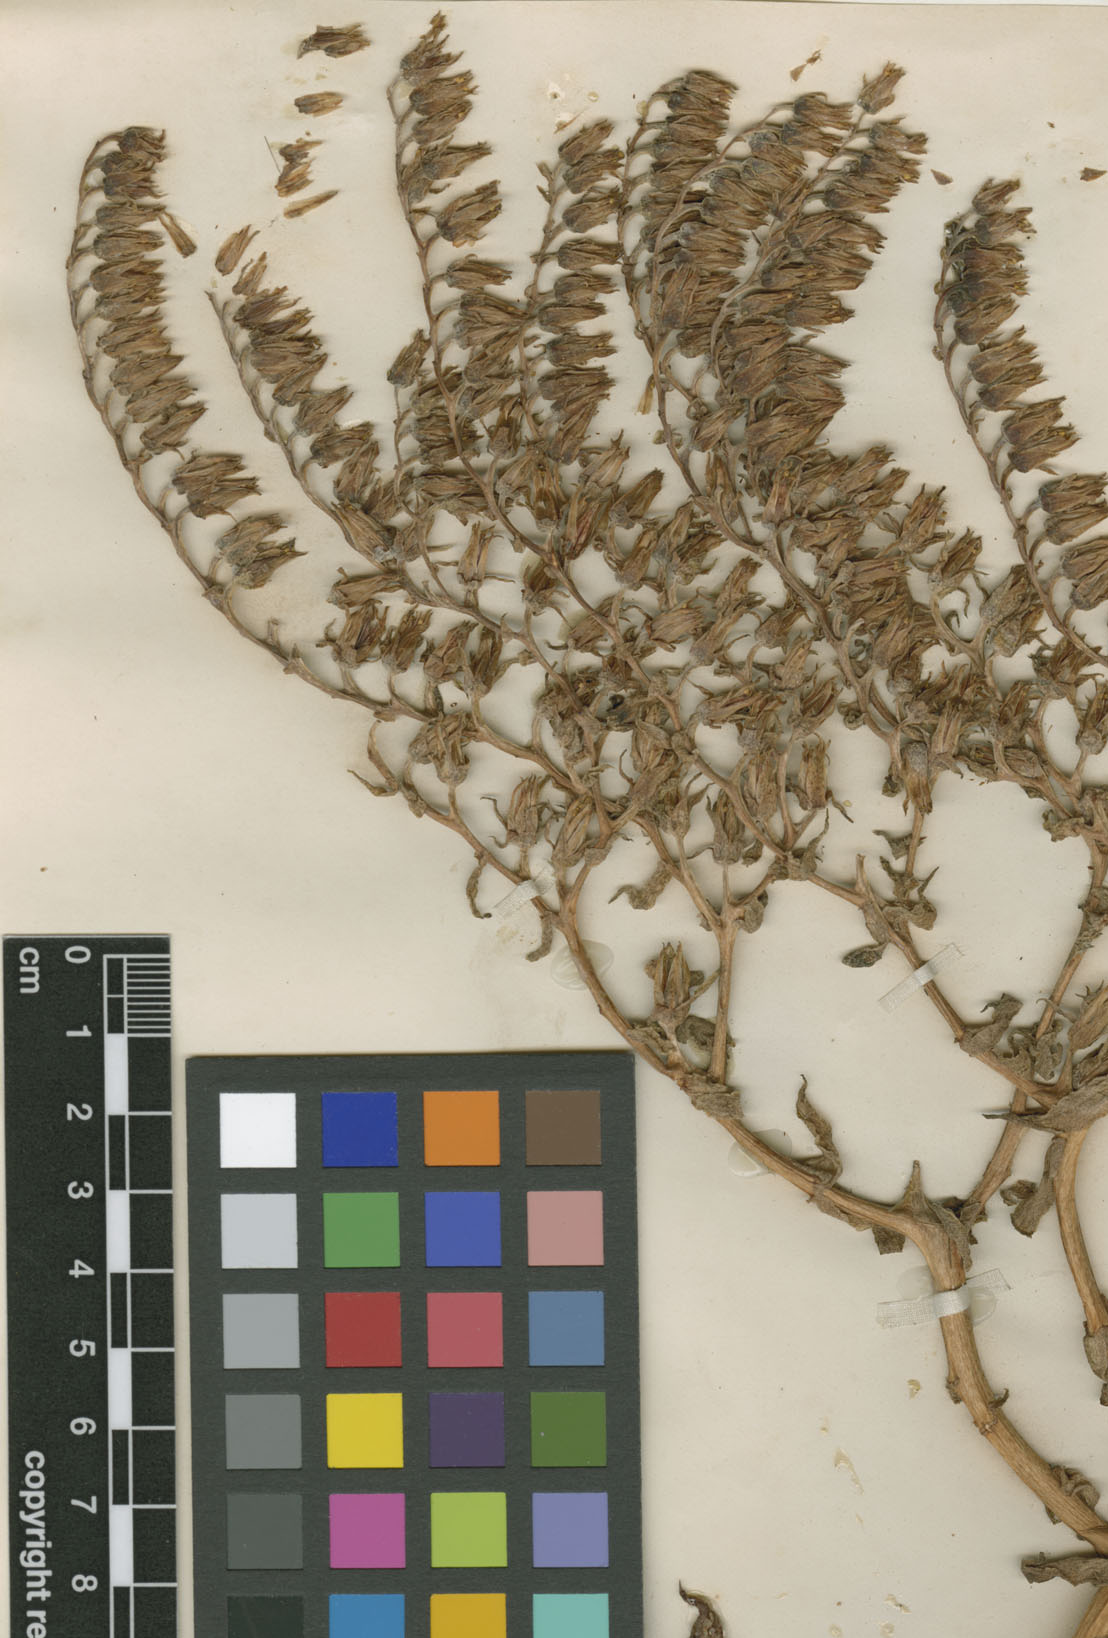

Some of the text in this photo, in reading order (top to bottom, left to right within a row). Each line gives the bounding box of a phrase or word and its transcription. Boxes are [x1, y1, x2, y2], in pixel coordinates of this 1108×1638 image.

[64, 945, 92, 964] 0
[19, 946, 41, 995] cm
[65, 1025, 92, 1038] 1
[67, 1103, 93, 1121] 2
[67, 1181, 94, 1200] 3
[68, 1259, 95, 1278] 4
[69, 1339, 96, 1357] 5
[69, 1416, 97, 1436] 6
[70, 1495, 97, 1514] 7
[19, 1450, 53, 1602] copyright
[71, 1573, 99, 1593] 8
